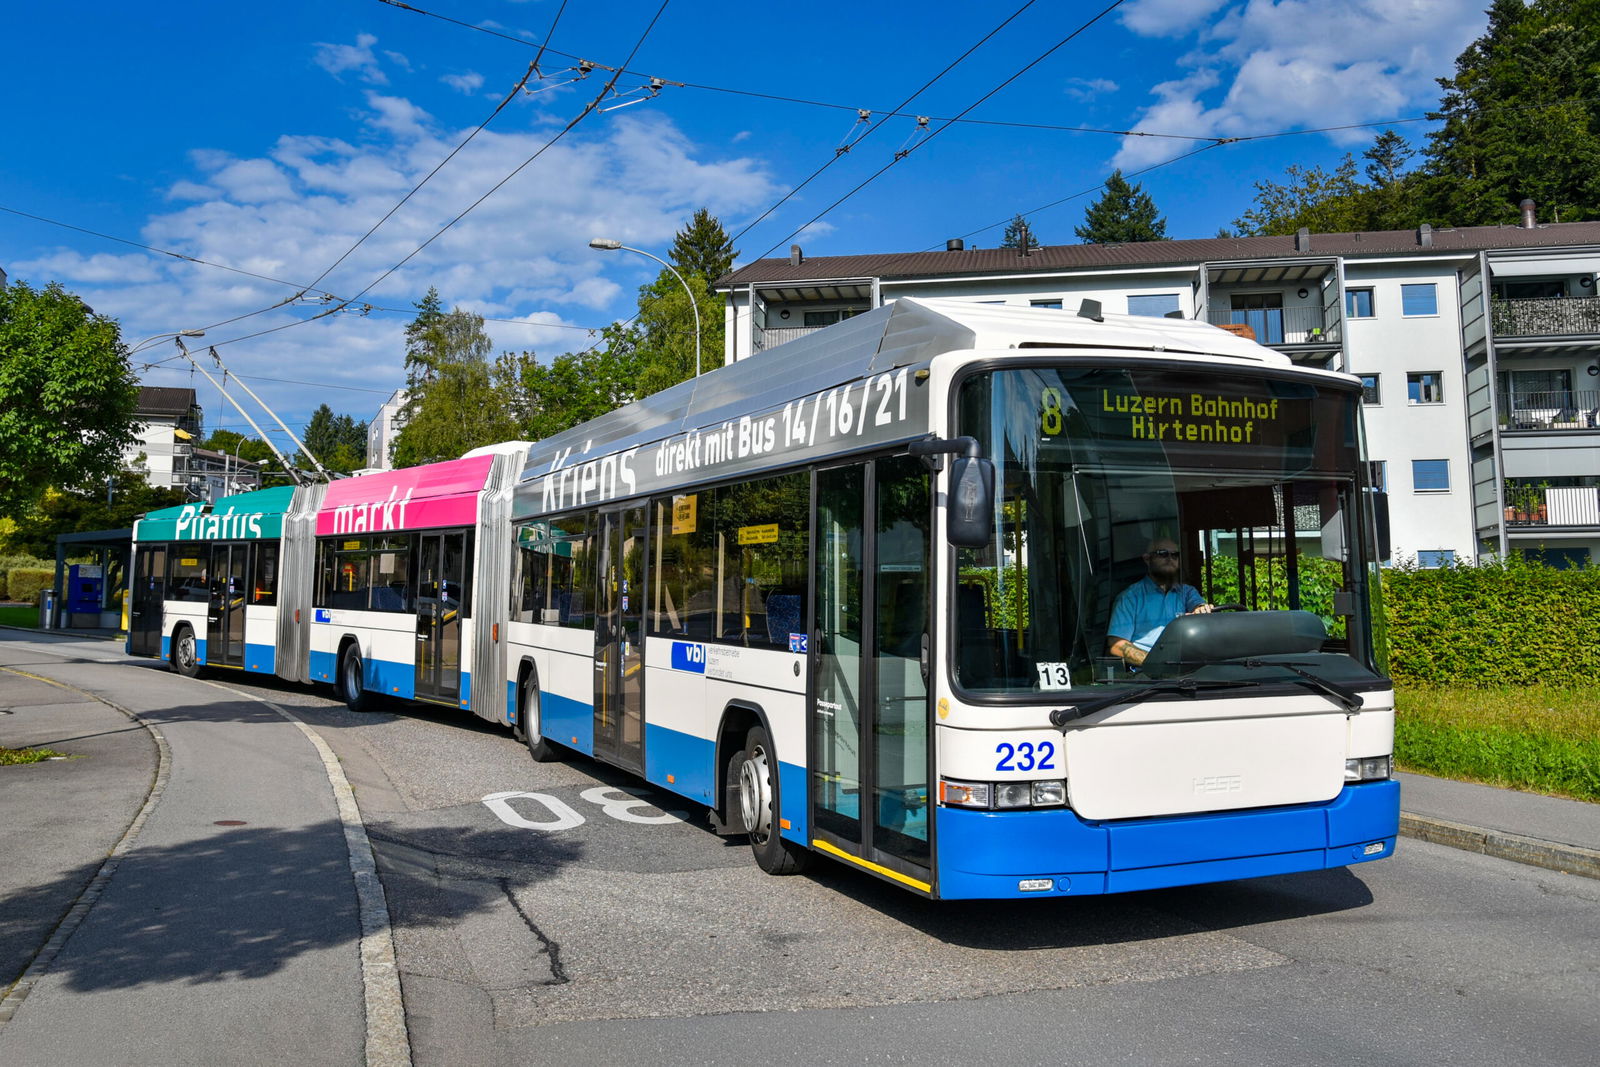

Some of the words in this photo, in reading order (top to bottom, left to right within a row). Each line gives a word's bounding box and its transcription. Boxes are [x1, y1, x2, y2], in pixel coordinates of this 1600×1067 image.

[1041, 387, 1062, 436] 8
[1103, 389, 1182, 415] Luzern
[1191, 394, 1279, 419] Bahnhof
[1132, 416, 1254, 443] Hirtenhof
[655, 428, 701, 477] direkt
[704, 422, 734, 466] mit
[738, 415, 776, 458] Bus
[542, 439, 640, 513] Kriens
[333, 485, 414, 534] markt
[685, 644, 705, 664] vbl
[1042, 667, 1068, 686] 13
[995, 741, 1055, 771] 232
